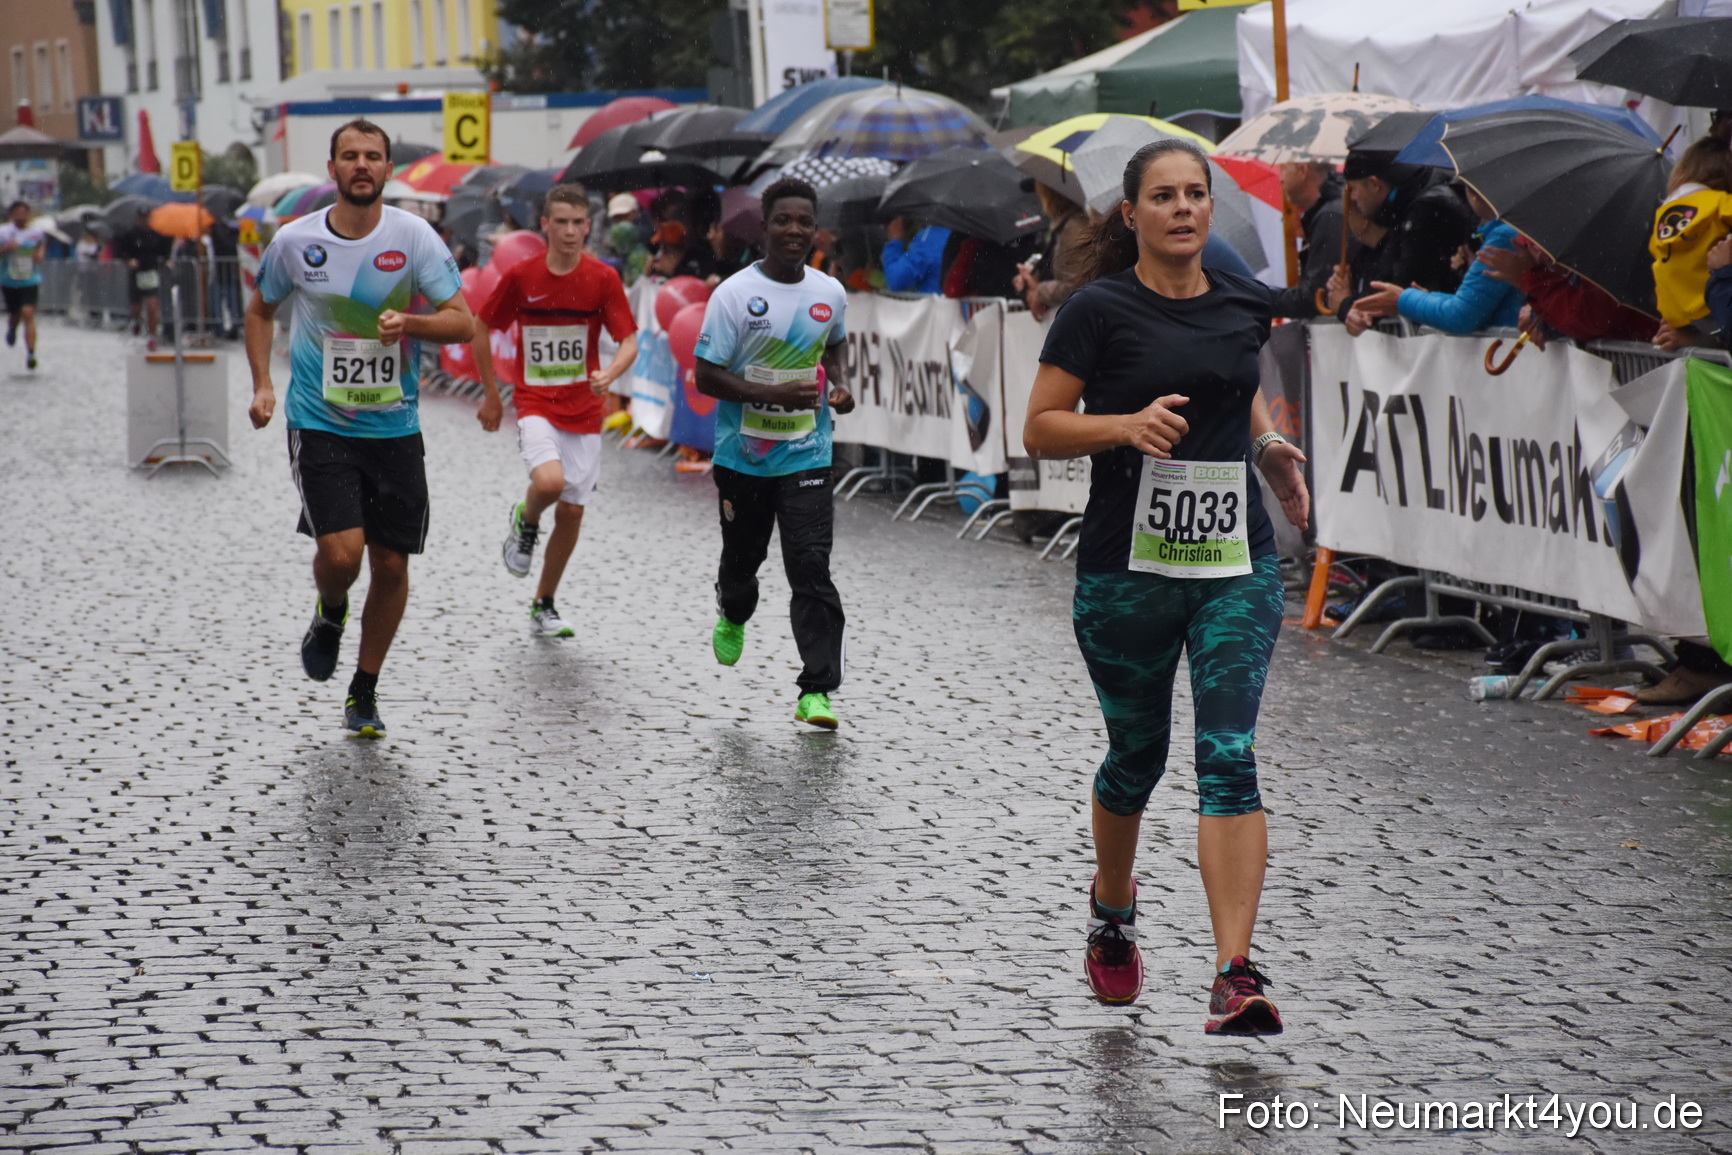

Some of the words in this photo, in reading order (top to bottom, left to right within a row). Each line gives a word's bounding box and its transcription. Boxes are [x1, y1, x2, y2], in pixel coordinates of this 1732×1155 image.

[456, 114, 478, 148] C
[177, 156, 193, 180] D
[303, 270, 328, 278] PARTL
[531, 339, 583, 362] 5166
[332, 355, 394, 384] 5219
[347, 391, 381, 403] Fabian
[762, 418, 796, 430] Mutala
[1151, 470, 1187, 481] NeuerMarkt
[1193, 465, 1239, 480] BOCK
[799, 478, 824, 488] SPORT
[1148, 487, 1239, 533] 5033
[1159, 543, 1222, 562] Christian
